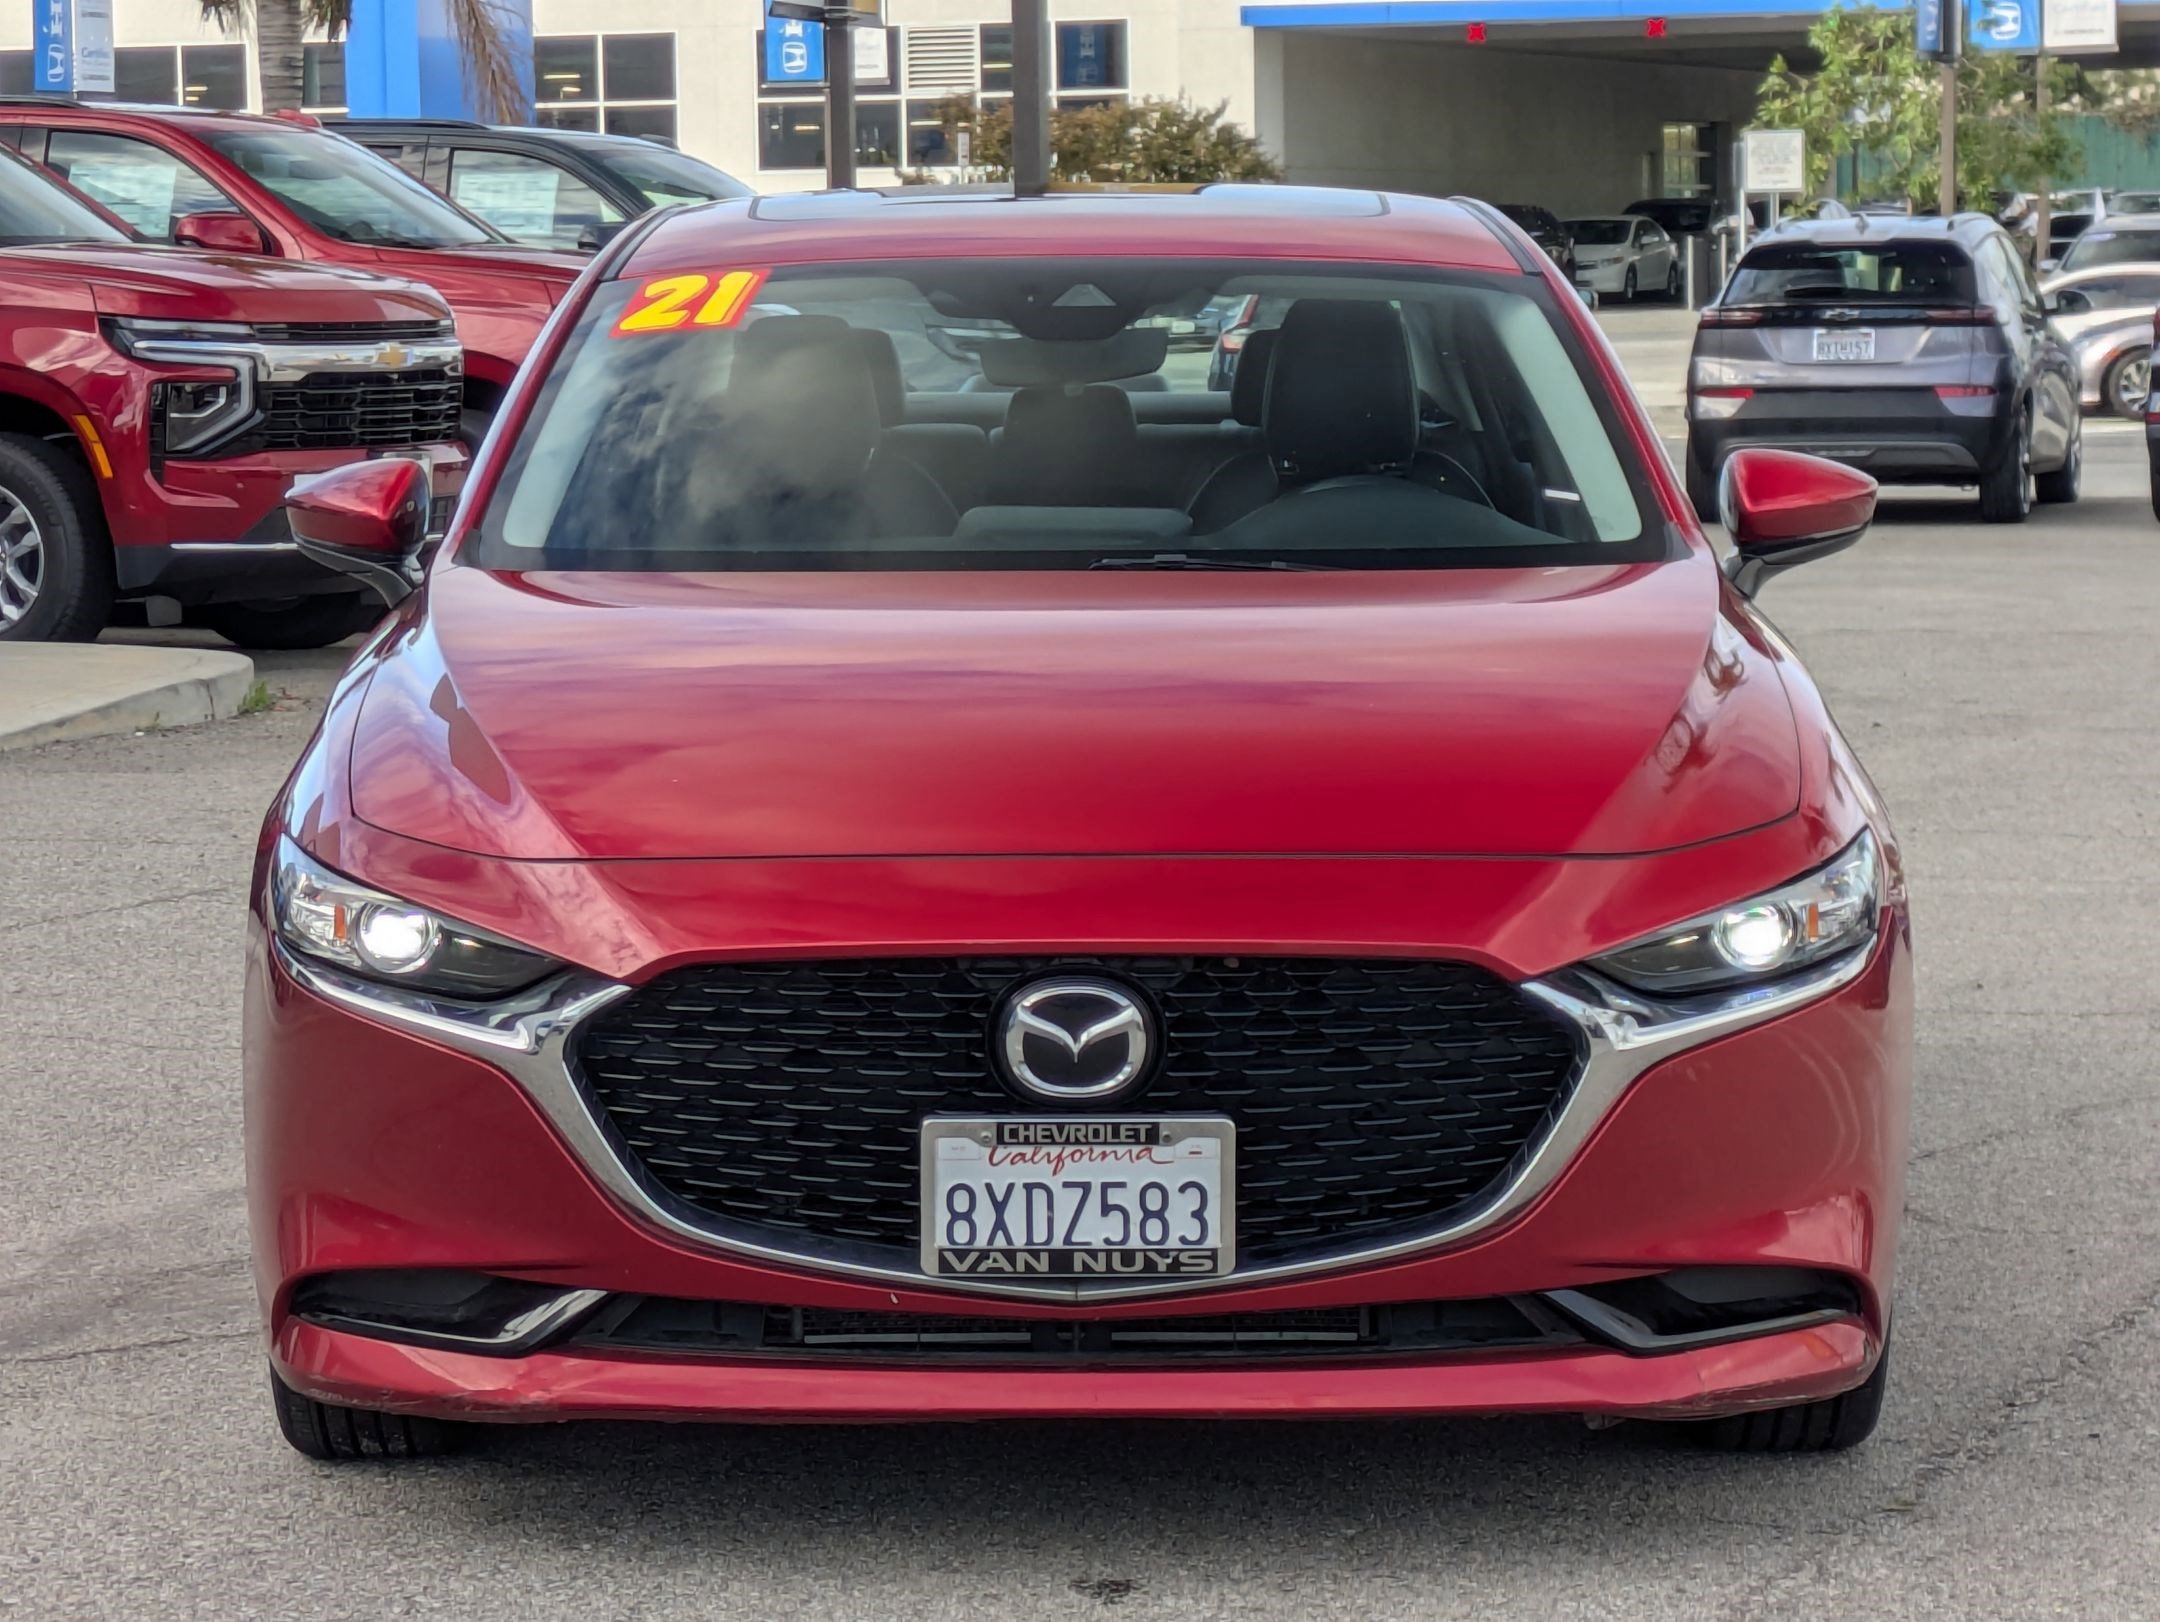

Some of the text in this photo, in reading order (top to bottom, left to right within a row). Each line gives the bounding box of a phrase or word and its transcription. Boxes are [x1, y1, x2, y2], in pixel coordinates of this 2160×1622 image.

[618, 271, 760, 332] 21
[1003, 1123, 1152, 1144] CHEVROLET
[988, 1145, 1174, 1176] California
[945, 1180, 1209, 1247] 8XDZ583
[941, 1250, 1215, 1273] VAN NUYS
